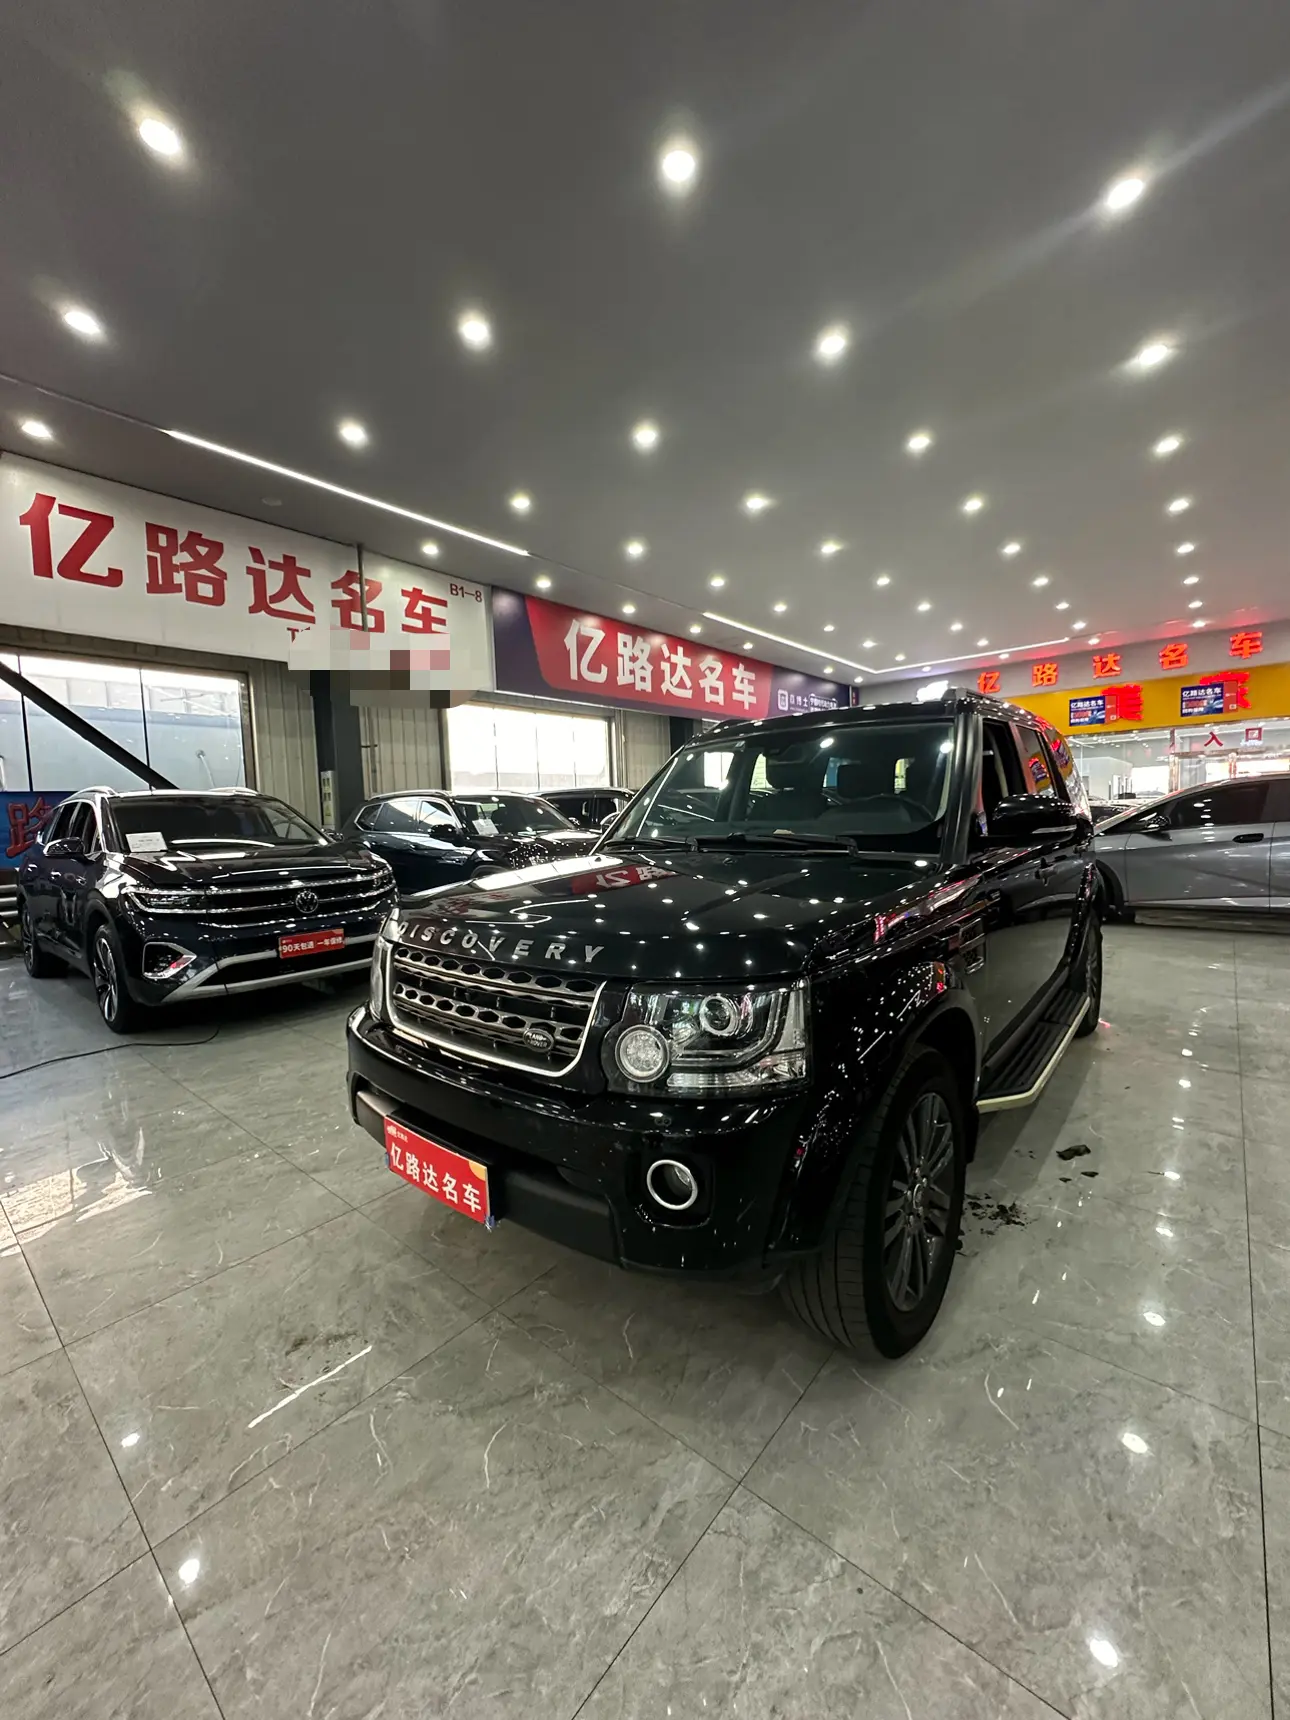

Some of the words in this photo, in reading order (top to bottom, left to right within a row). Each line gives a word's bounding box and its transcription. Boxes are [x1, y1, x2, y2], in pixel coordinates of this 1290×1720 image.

[19, 492, 449, 634] 亿路达名车
[563, 619, 757, 710] 亿路达名车
[977, 631, 1263, 694] 亿路达名车
[1204, 727, 1263, 747] 入口
[397, 921, 605, 963] DISCOVERY
[390, 1142, 482, 1213] 亿路达名车
